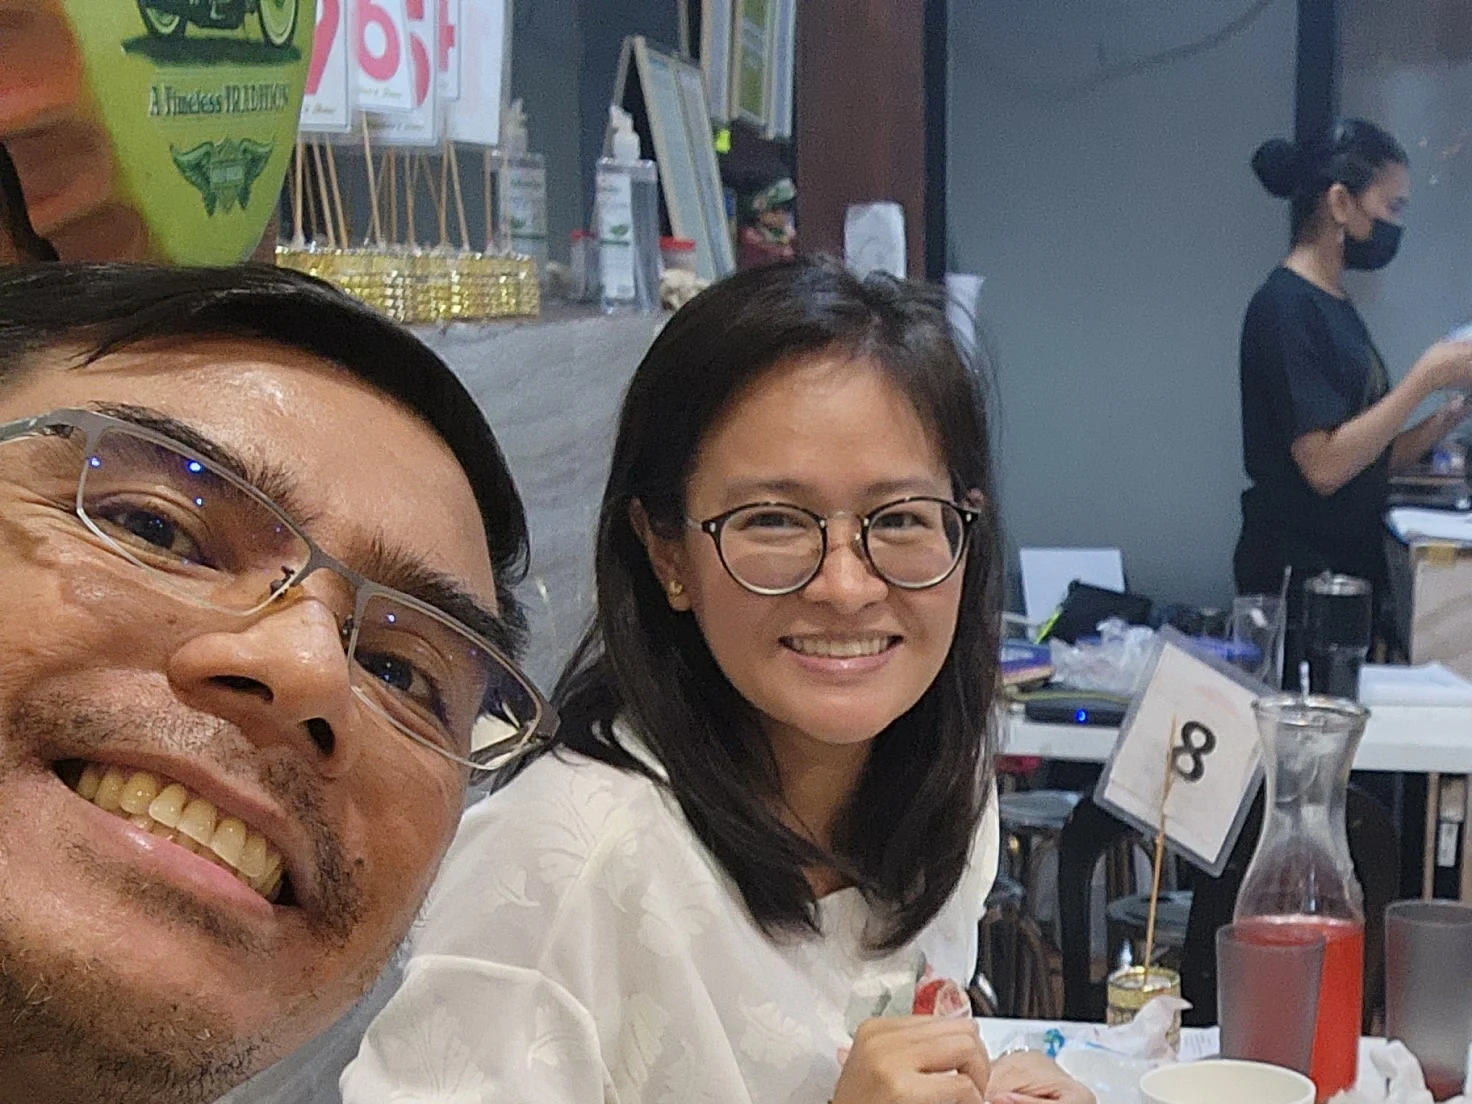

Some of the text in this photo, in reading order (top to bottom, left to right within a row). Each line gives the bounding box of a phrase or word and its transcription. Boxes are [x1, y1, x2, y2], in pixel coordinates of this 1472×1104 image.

[150, 85, 160, 115] A
[164, 84, 222, 115] Timeless
[1170, 720, 1216, 783] 8
